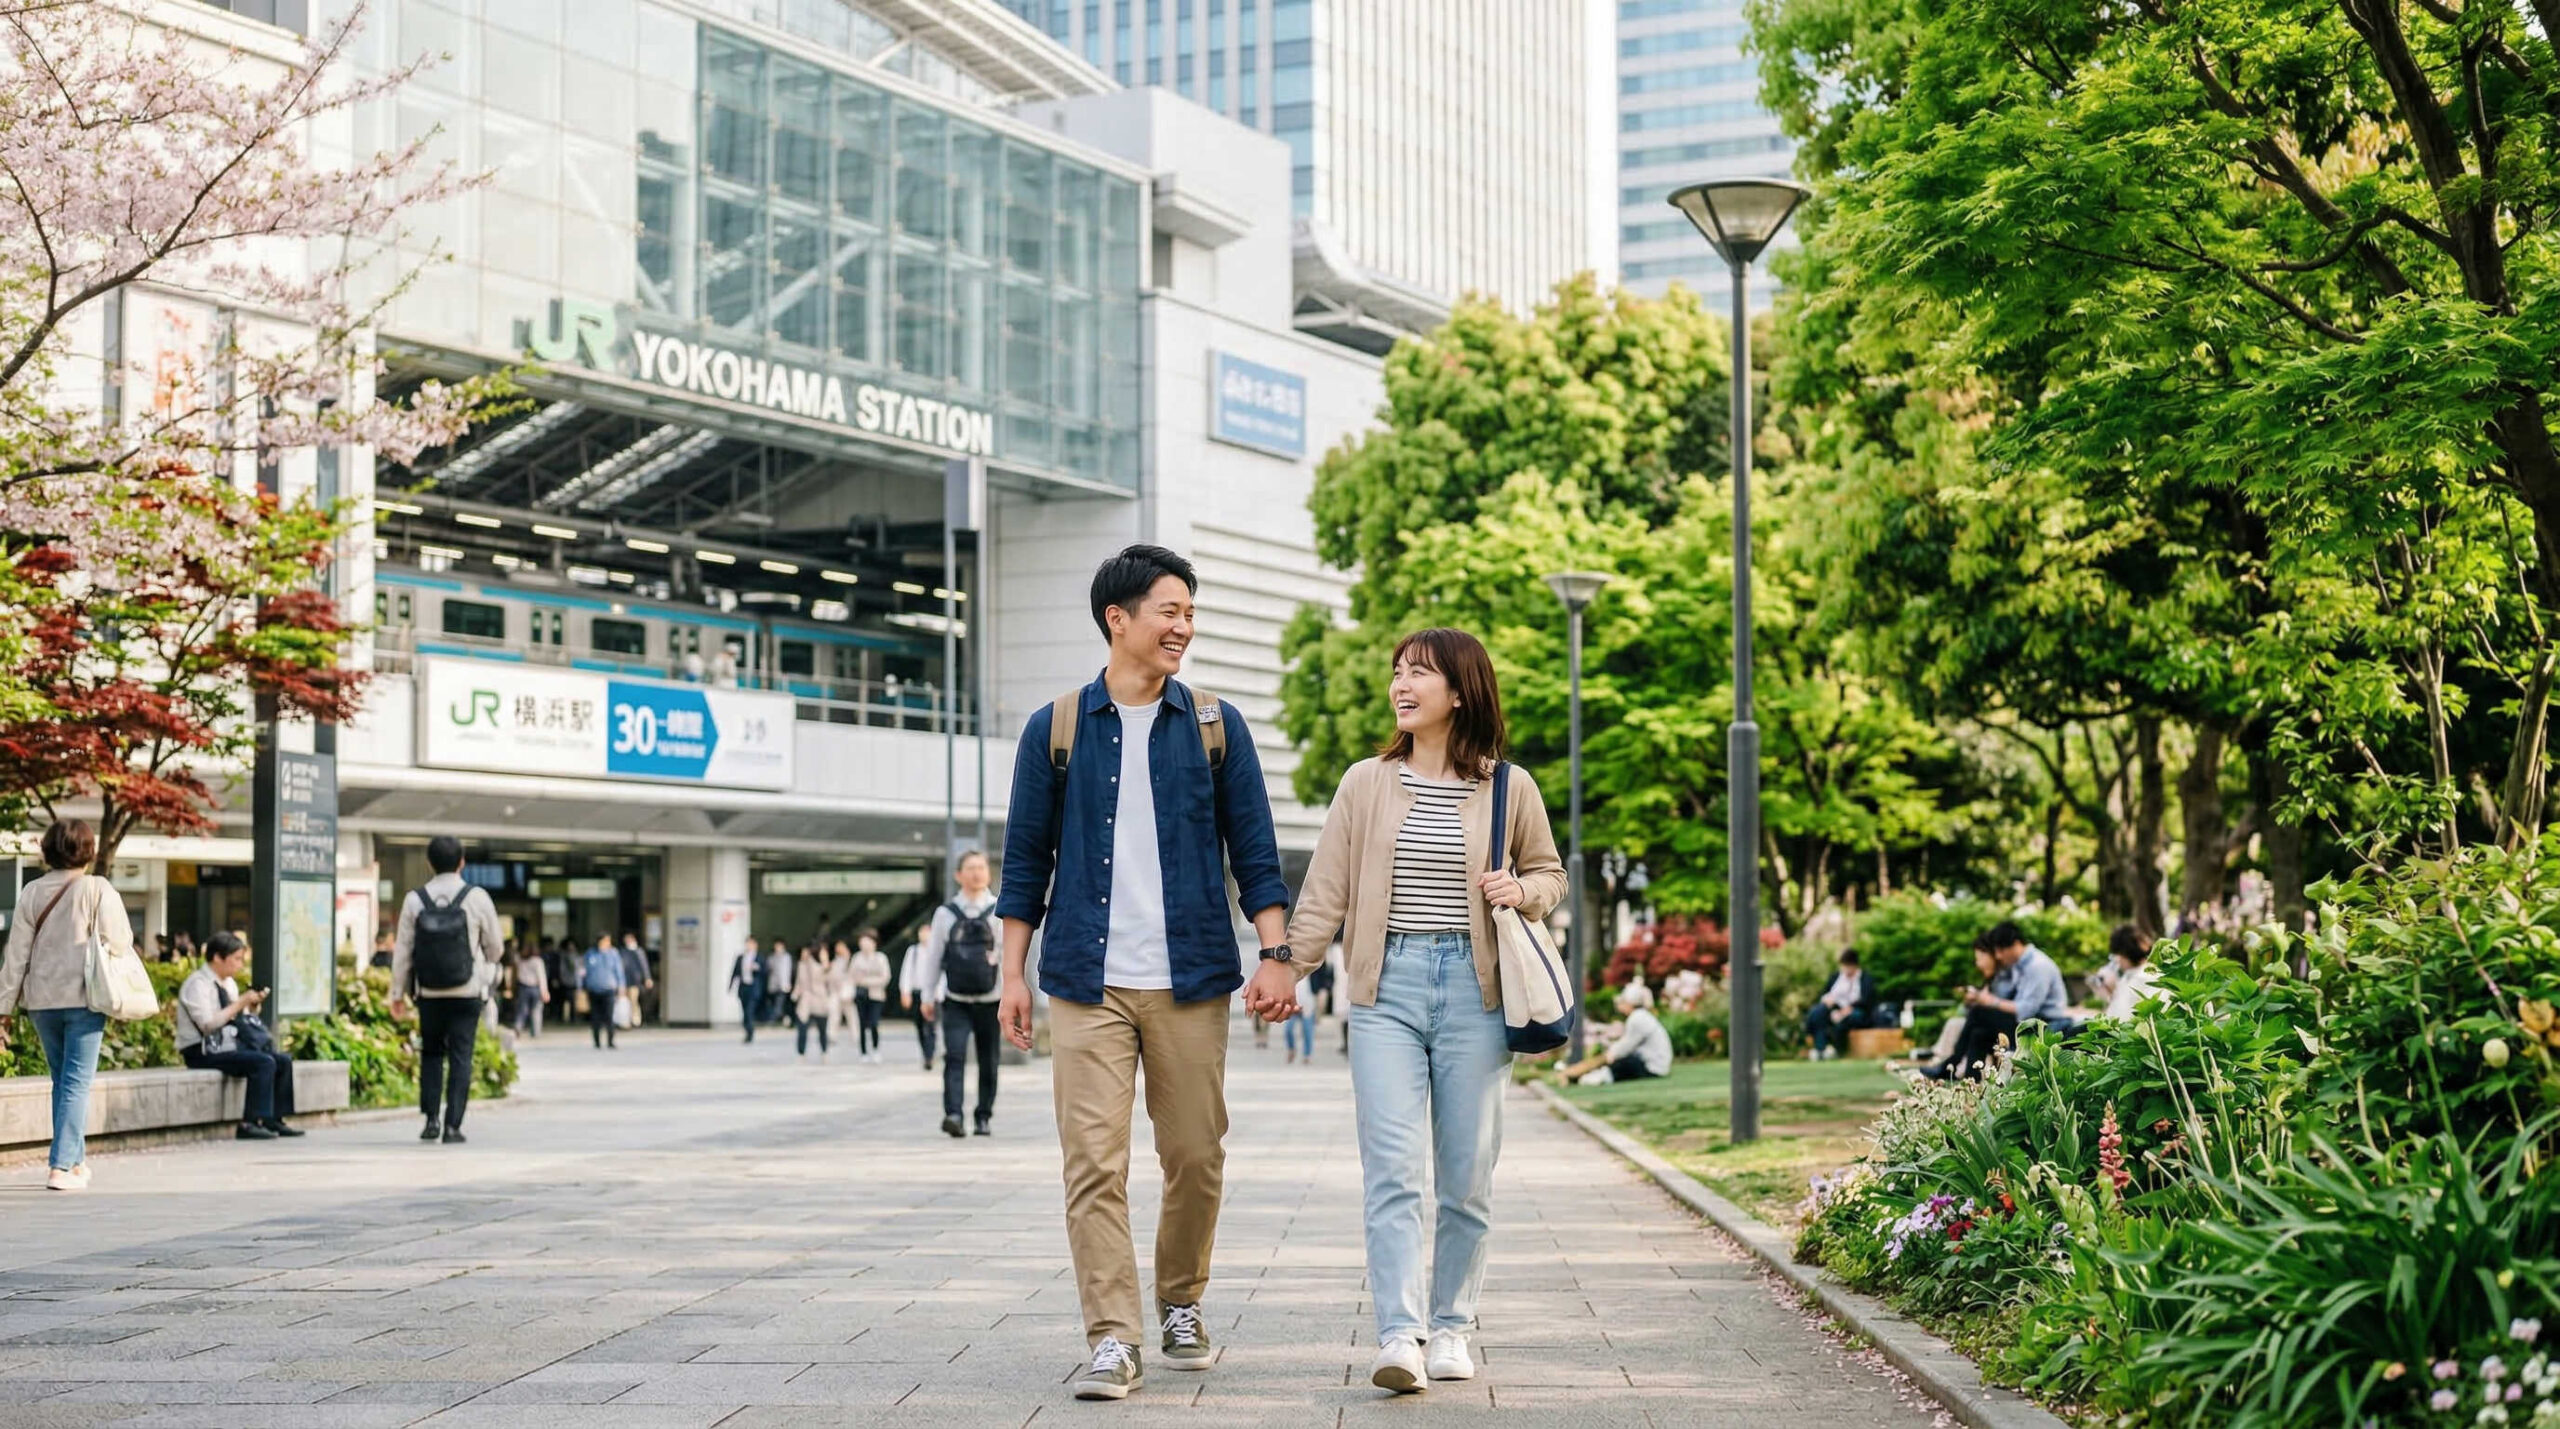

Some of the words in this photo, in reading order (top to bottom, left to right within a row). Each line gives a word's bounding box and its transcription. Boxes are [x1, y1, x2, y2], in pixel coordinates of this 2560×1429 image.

[531, 299, 616, 370] JR
[633, 329, 847, 424] YOKOHAMA
[856, 383, 994, 455] STATION
[451, 690, 500, 727] JR
[514, 695, 593, 731] 横浜駅
[613, 703, 657, 755] 30
